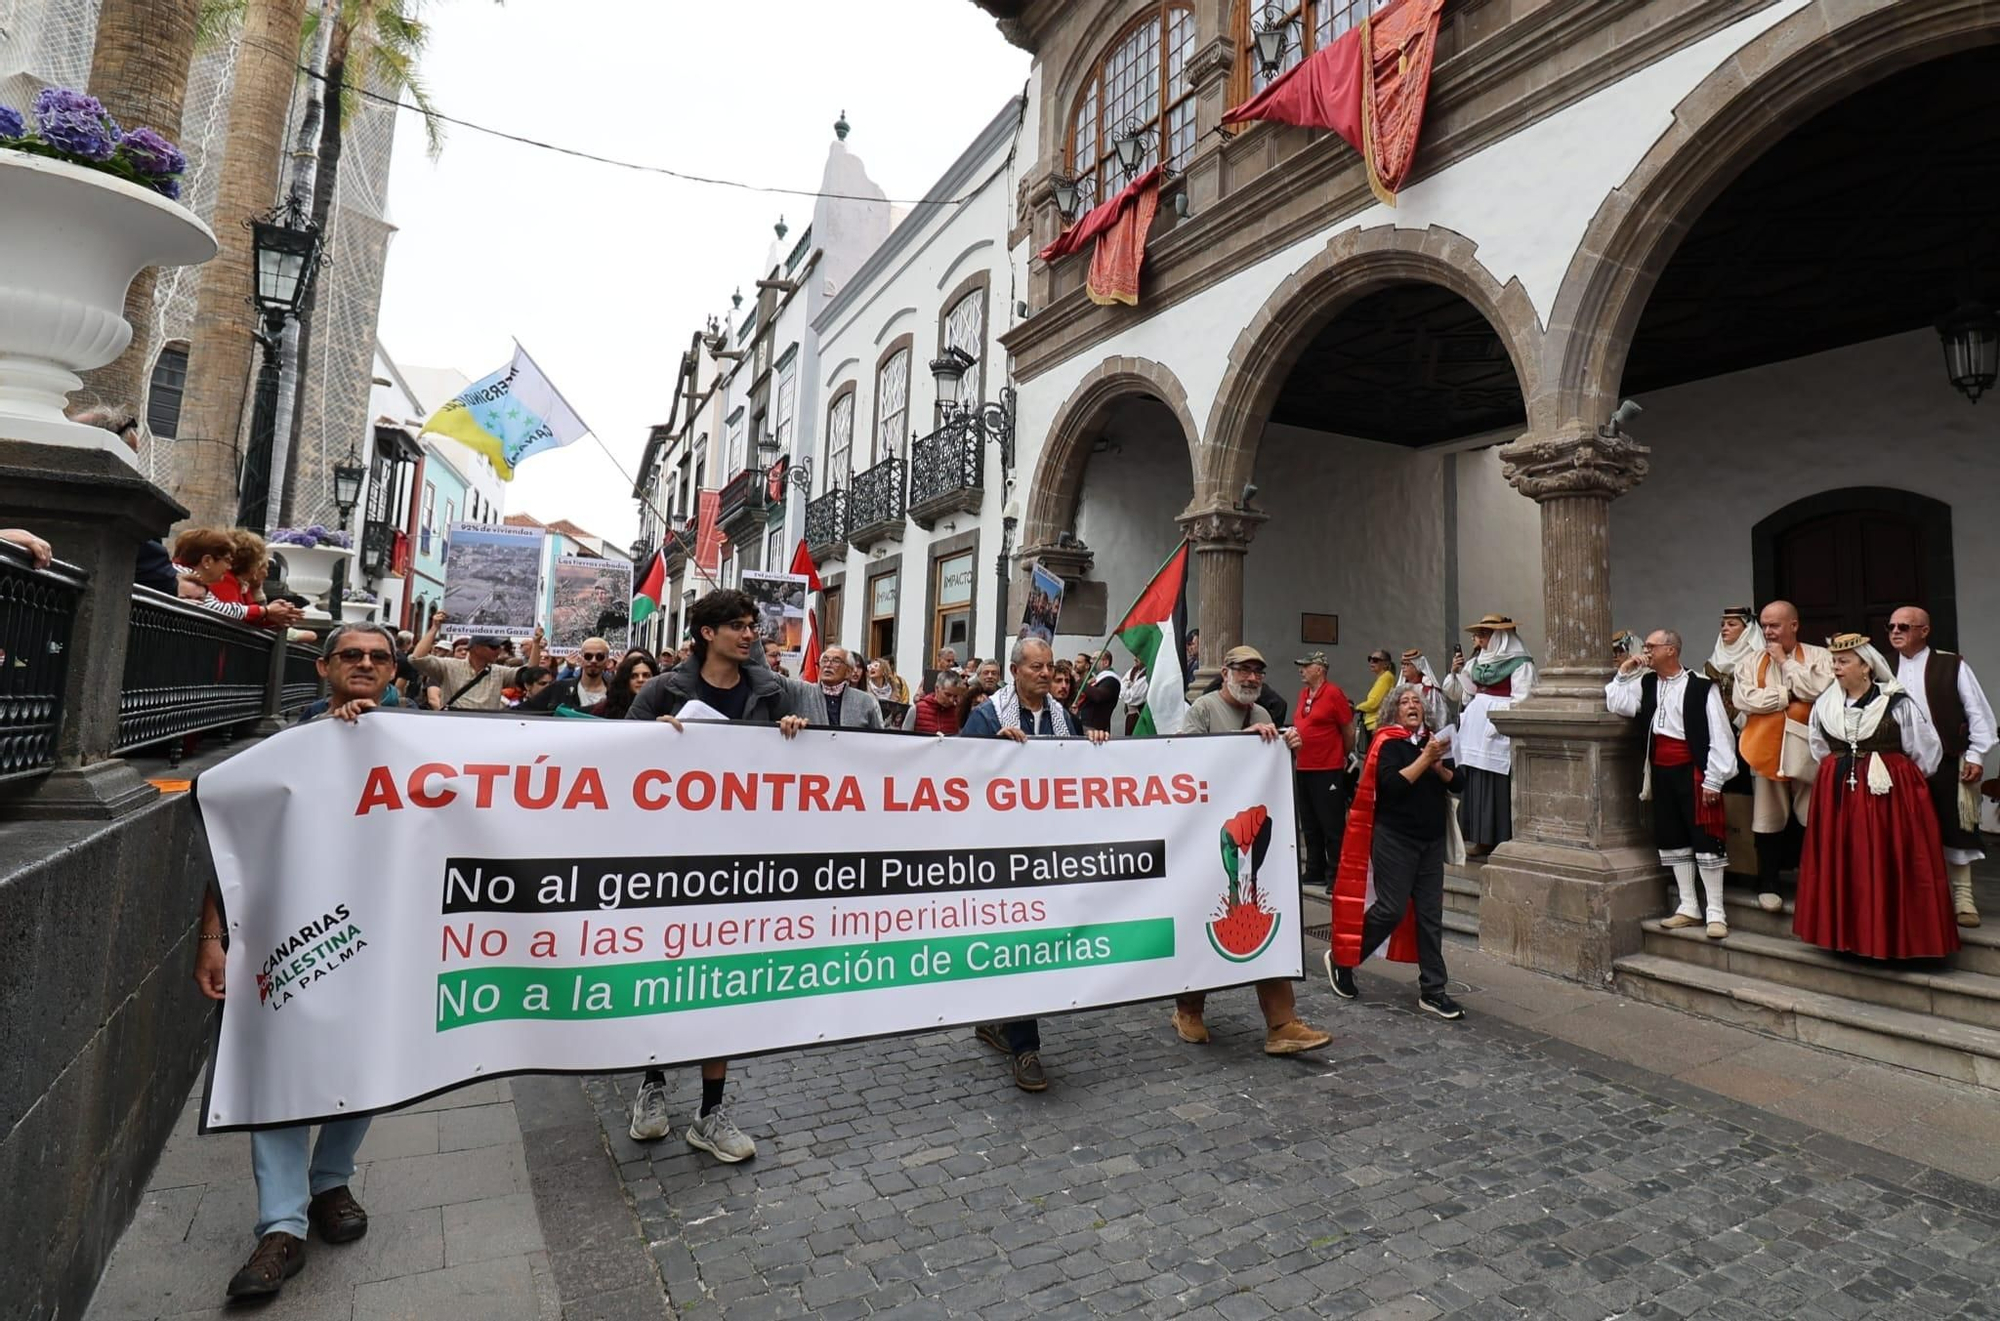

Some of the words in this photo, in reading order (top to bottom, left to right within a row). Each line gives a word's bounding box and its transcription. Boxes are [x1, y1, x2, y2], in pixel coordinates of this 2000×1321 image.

[480, 525, 491, 533] de
[492, 527, 534, 537] viviendas
[943, 570, 973, 589] IMPACTO
[506, 627, 530, 636] Gaza
[355, 754, 609, 816] ACTÚA
[632, 768, 867, 813] CONTRA
[882, 776, 971, 813] LAS
[985, 773, 1210, 812] GUERRAS:
[447, 866, 516, 904] No
[537, 865, 578, 904] al
[597, 860, 800, 911] genocidio
[814, 857, 866, 892] del
[881, 854, 997, 889] Pueblo
[1009, 847, 1154, 882] Palestino
[262, 903, 350, 977] CANARIAS
[441, 922, 509, 961] No
[529, 928, 558, 960] a
[579, 919, 645, 959] las
[662, 911, 816, 960] guerras
[830, 896, 1048, 941] imperialistas
[267, 923, 362, 999] PALESTINA
[272, 991, 294, 1012] LA
[298, 939, 368, 990] PALMA
[439, 979, 501, 1022] No
[523, 984, 551, 1012] a
[572, 974, 613, 1012] la
[633, 948, 896, 1008] militarización
[910, 944, 952, 978] de
[966, 933, 1112, 972] Canarias
